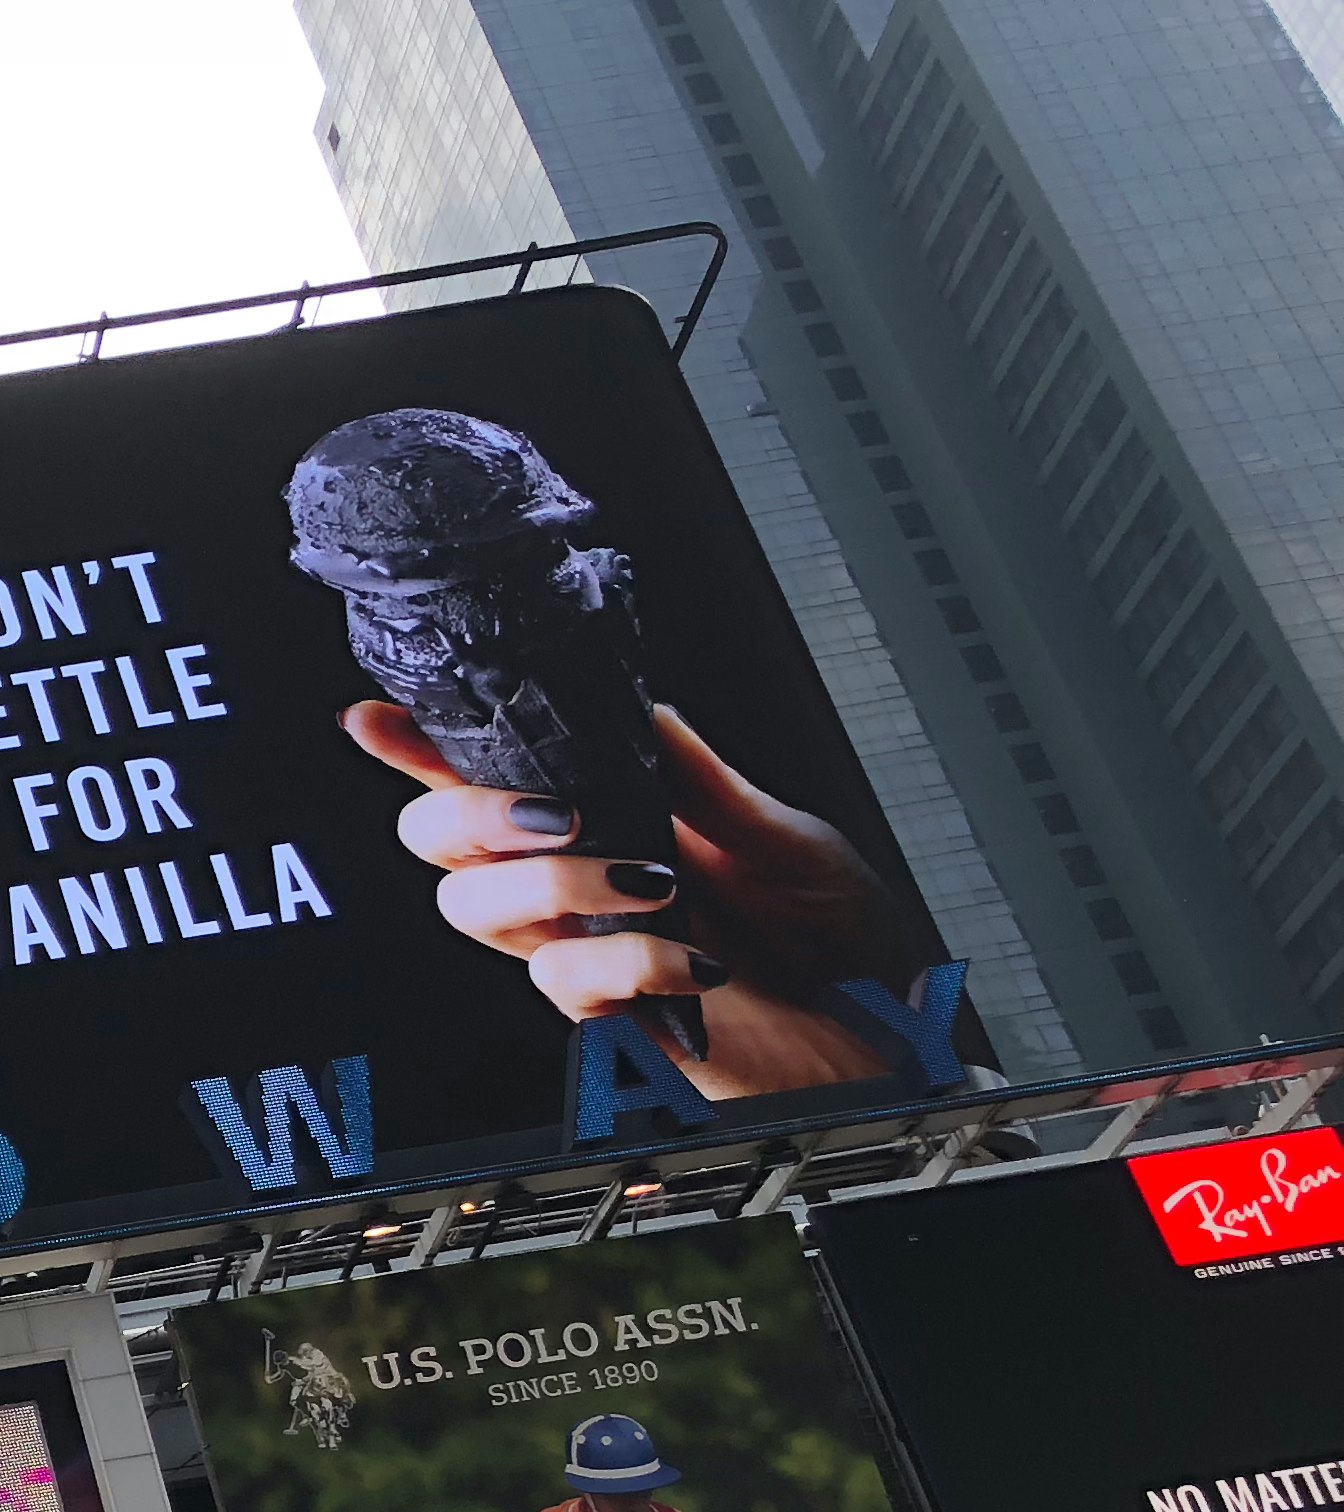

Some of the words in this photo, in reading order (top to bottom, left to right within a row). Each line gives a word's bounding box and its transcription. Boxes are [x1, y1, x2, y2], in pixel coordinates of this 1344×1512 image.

[13, 756, 194, 852] FOR
[1193, 1257, 1275, 1280] GENUINE
[1279, 1248, 1334, 1266] SINCE
[362, 1346, 454, 1391] U.S.
[459, 1321, 599, 1376] POLO
[612, 1296, 760, 1353] ASSN.
[488, 1372, 582, 1407] SINCE
[591, 1360, 659, 1392] 1890
